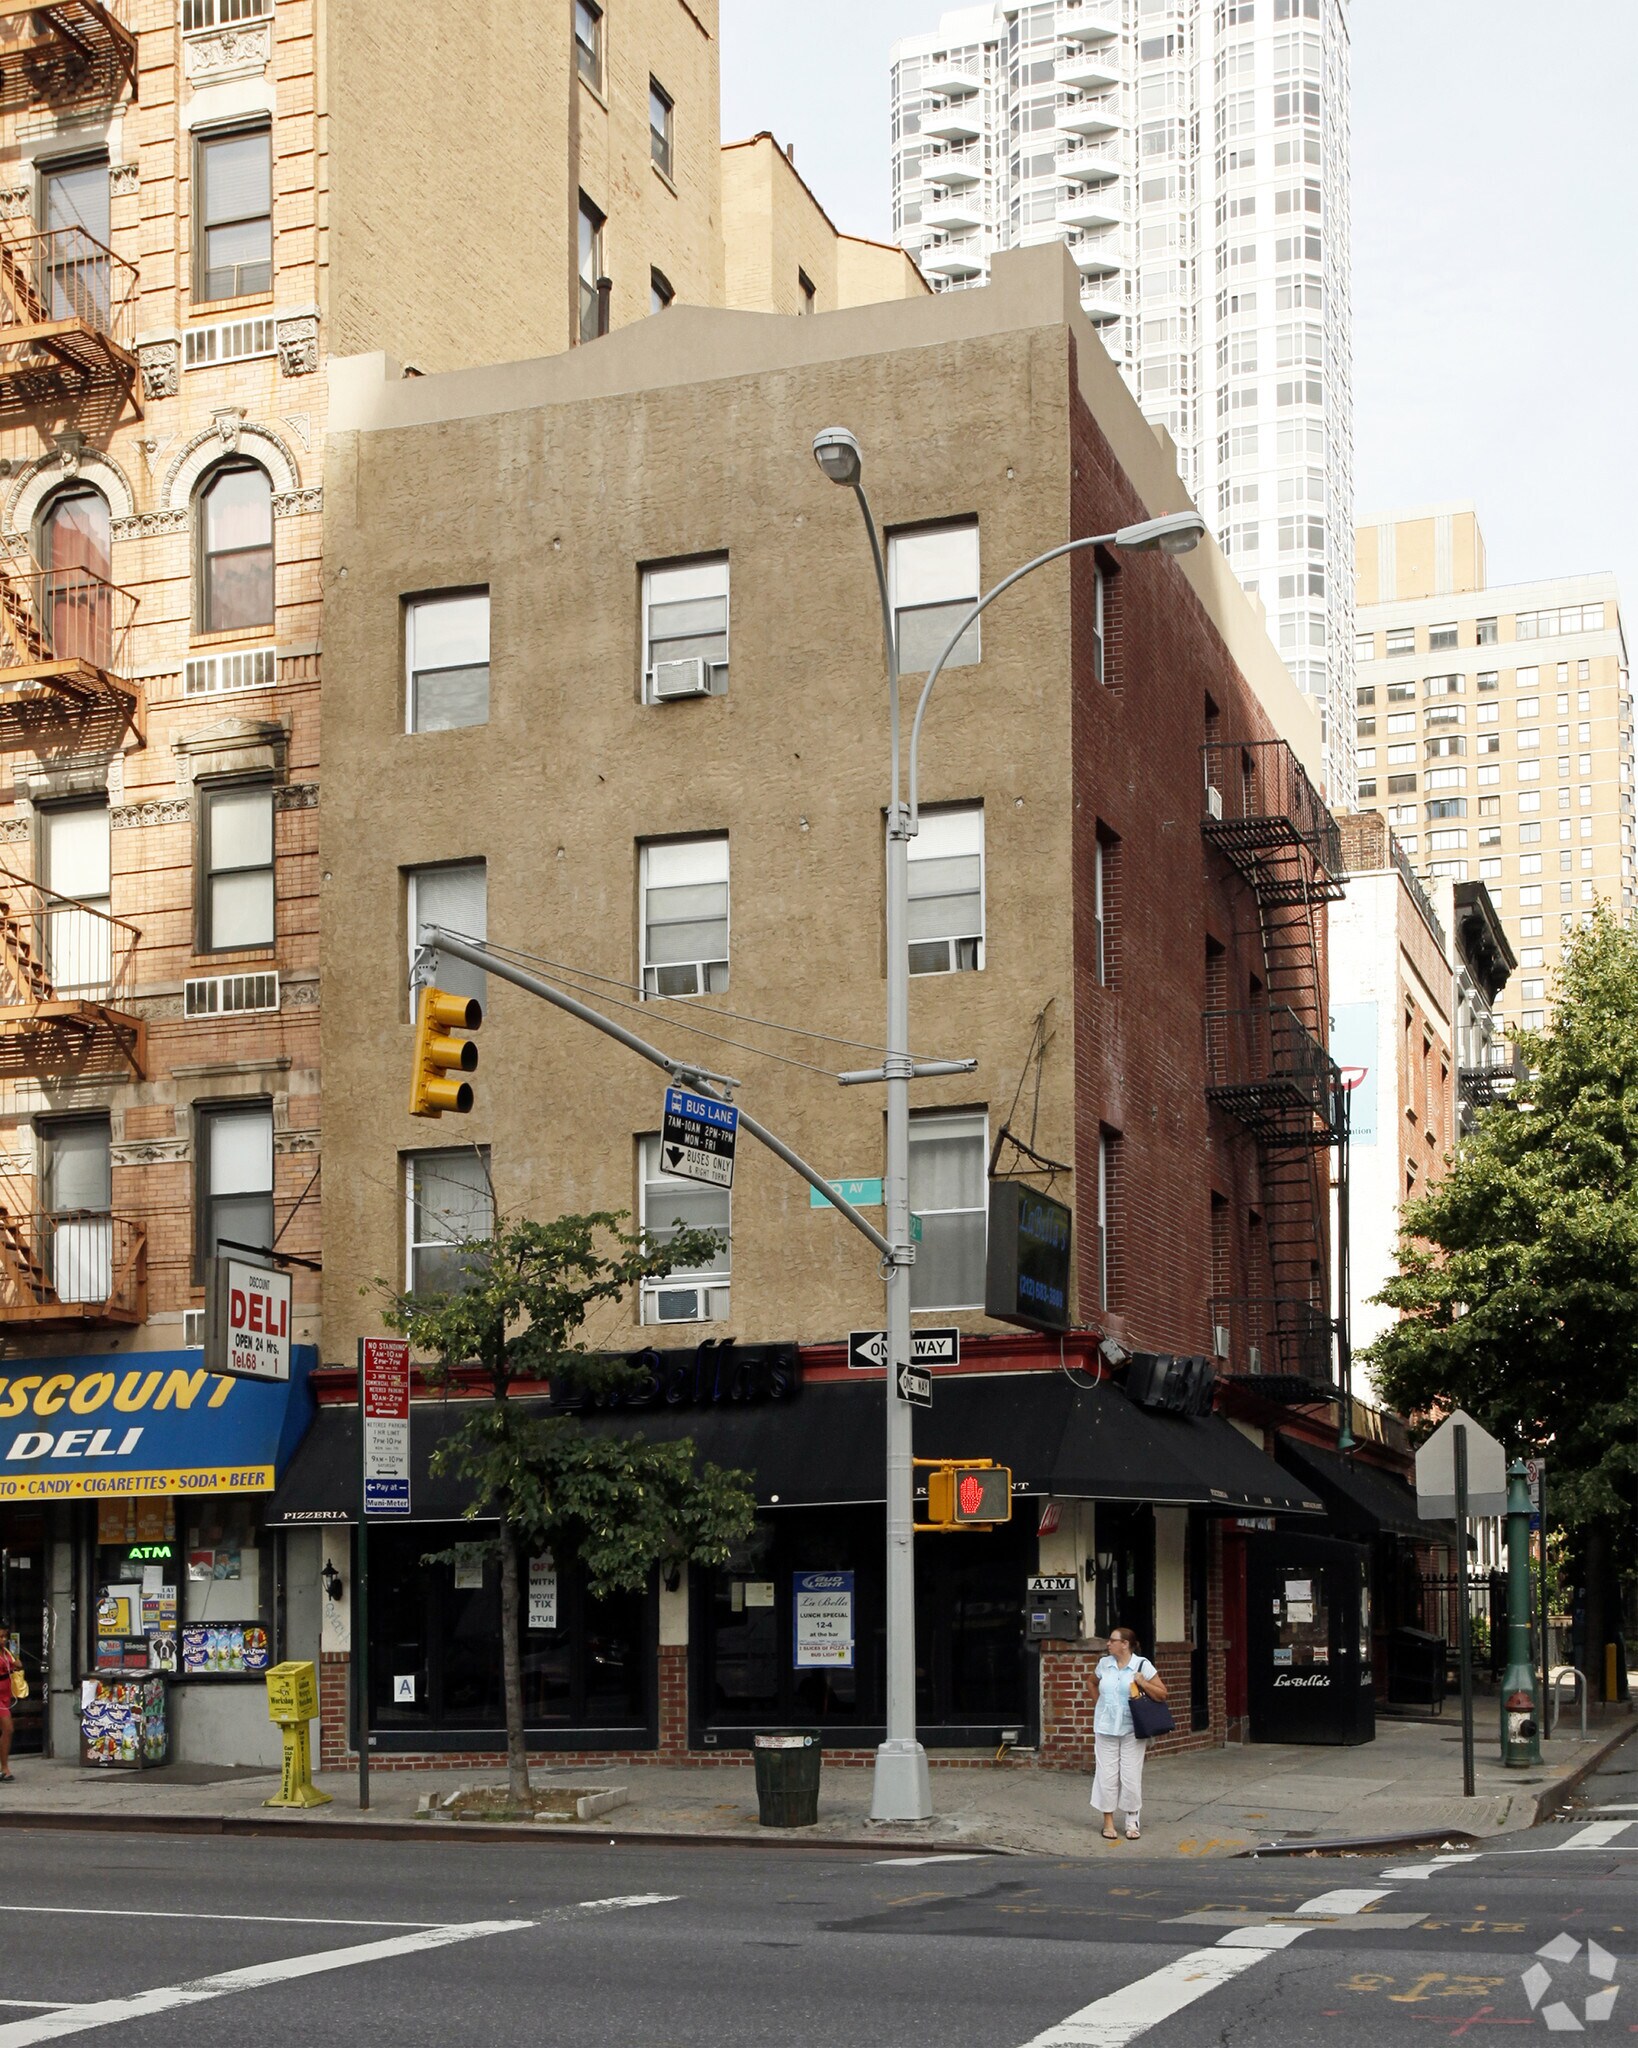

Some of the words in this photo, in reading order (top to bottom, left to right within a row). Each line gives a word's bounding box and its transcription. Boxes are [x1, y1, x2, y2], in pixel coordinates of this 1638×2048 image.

[686, 1100, 706, 1116] BUS
[708, 1106, 733, 1124] LANE
[668, 1115, 700, 1133] 7AM-10AM
[704, 1126, 734, 1143] 2PM-7PM
[684, 1134, 700, 1147] MON
[705, 1139, 716, 1151] FRI
[687, 1150, 710, 1167] BUSES
[713, 1156, 730, 1172] ONLY
[695, 1166, 710, 1178] RIGHT
[712, 1170, 727, 1182] TURNS
[849, 1183, 864, 1194] AV
[230, 1288, 286, 1338] DELI
[235, 1333, 253, 1350] OPEN
[256, 1338, 263, 1352] 24
[266, 1339, 280, 1355] Hrs.
[870, 1343, 888, 1356] ON
[914, 1340, 946, 1354] WAY
[904, 1376, 914, 1391] ONE
[918, 1379, 928, 1394] WAY
[5, 1428, 144, 1460] DELI
[28, 1480, 74, 1494] CANDY
[84, 1476, 167, 1492] CIGARETTES
[178, 1474, 218, 1489] SODA
[230, 1472, 266, 1487] BEER
[376, 1483, 388, 1492] Pay
[283, 1511, 348, 1520] PIZZERIA
[129, 1546, 172, 1559] ATM
[530, 1578, 555, 1586] WITH
[1032, 1578, 1071, 1590] ATM
[534, 1600, 552, 1608] TIX
[531, 1615, 554, 1623] STUB
[400, 1679, 412, 1694] A
[1273, 1674, 1330, 1687] LaBella's
